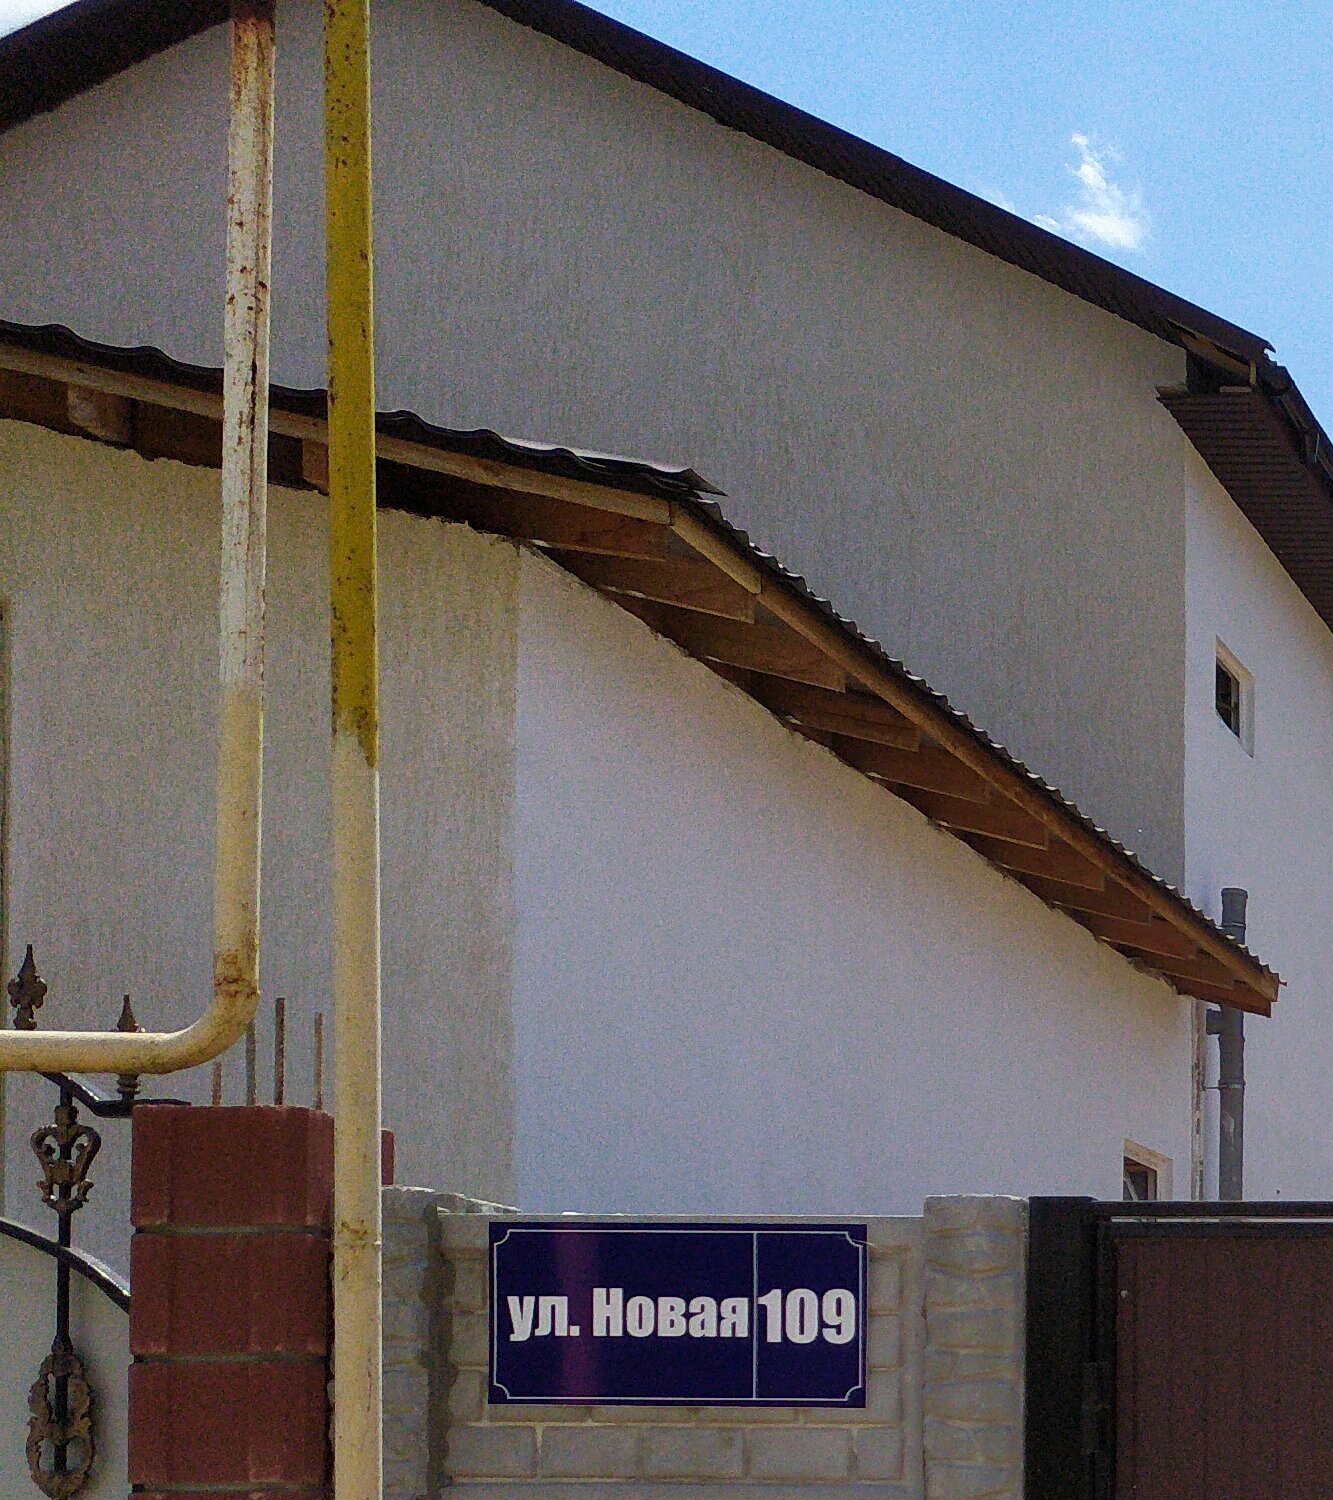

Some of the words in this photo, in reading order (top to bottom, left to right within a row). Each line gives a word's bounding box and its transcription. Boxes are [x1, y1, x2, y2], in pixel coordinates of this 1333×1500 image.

[507, 1295, 580, 1342] ул.
[592, 1287, 749, 1338] Новая
[757, 1288, 856, 1344] 109
